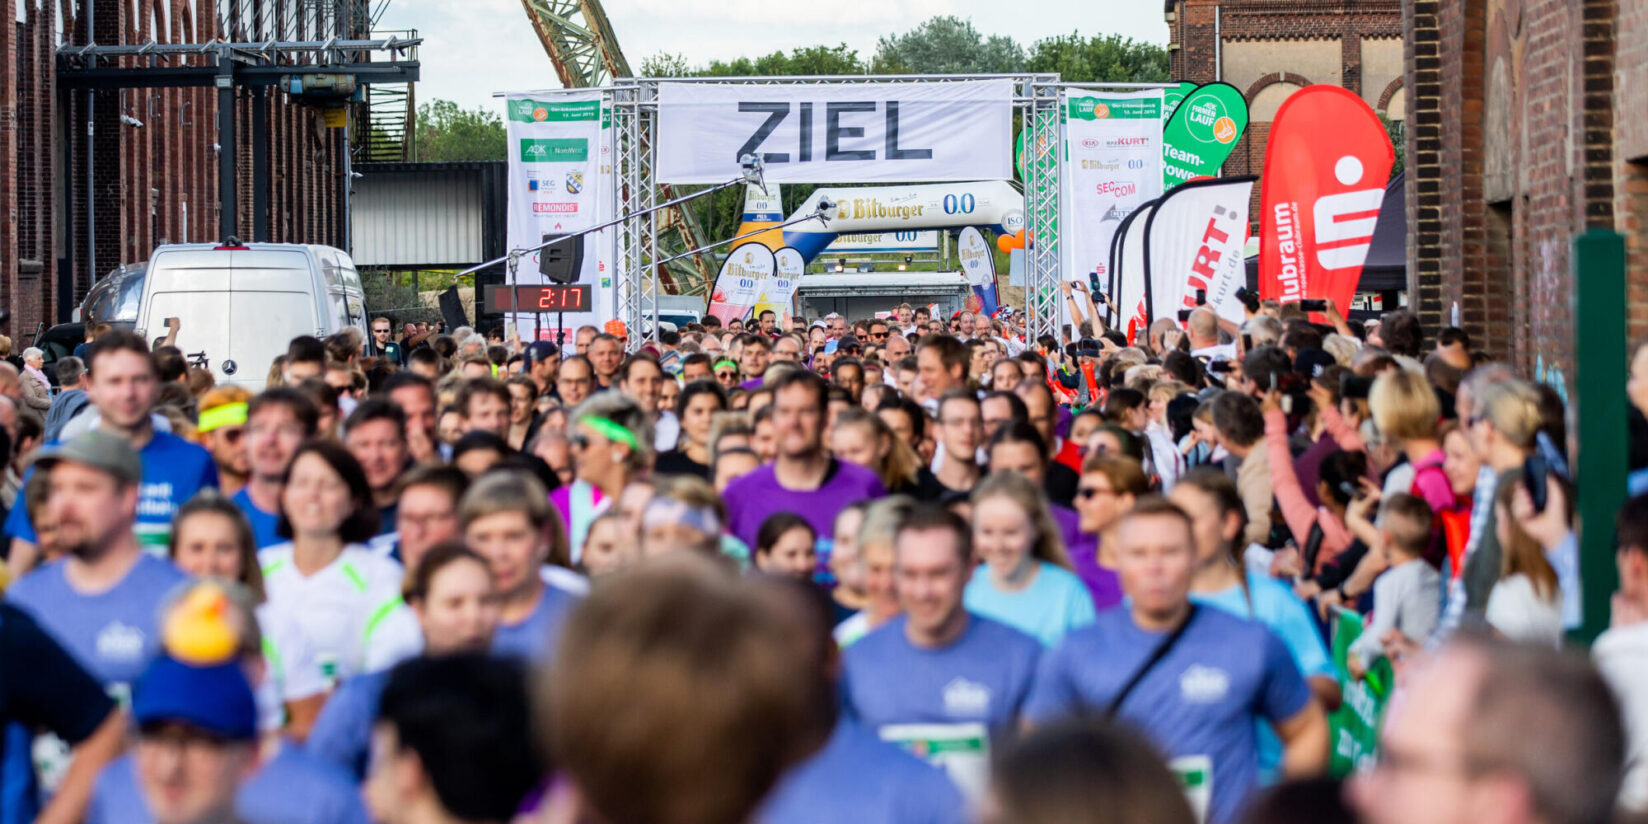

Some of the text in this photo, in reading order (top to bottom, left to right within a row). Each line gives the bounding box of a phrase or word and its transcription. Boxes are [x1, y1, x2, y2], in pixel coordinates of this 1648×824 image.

[1190, 111, 1215, 127] LAUF
[1191, 105, 1217, 118] FIRMEN
[737, 101, 933, 163] ZIEL
[526, 144, 547, 154] AOK
[1163, 143, 1205, 167] Team-
[542, 179, 556, 187] SEG
[533, 203, 575, 212] REMONDIS
[853, 198, 925, 220] Bitburger
[943, 193, 976, 215] 0.0
[1007, 215, 1023, 225] ISO
[1274, 202, 1301, 305] lubraum
[727, 263, 769, 281] Bitburger
[538, 287, 582, 309] 2:17
